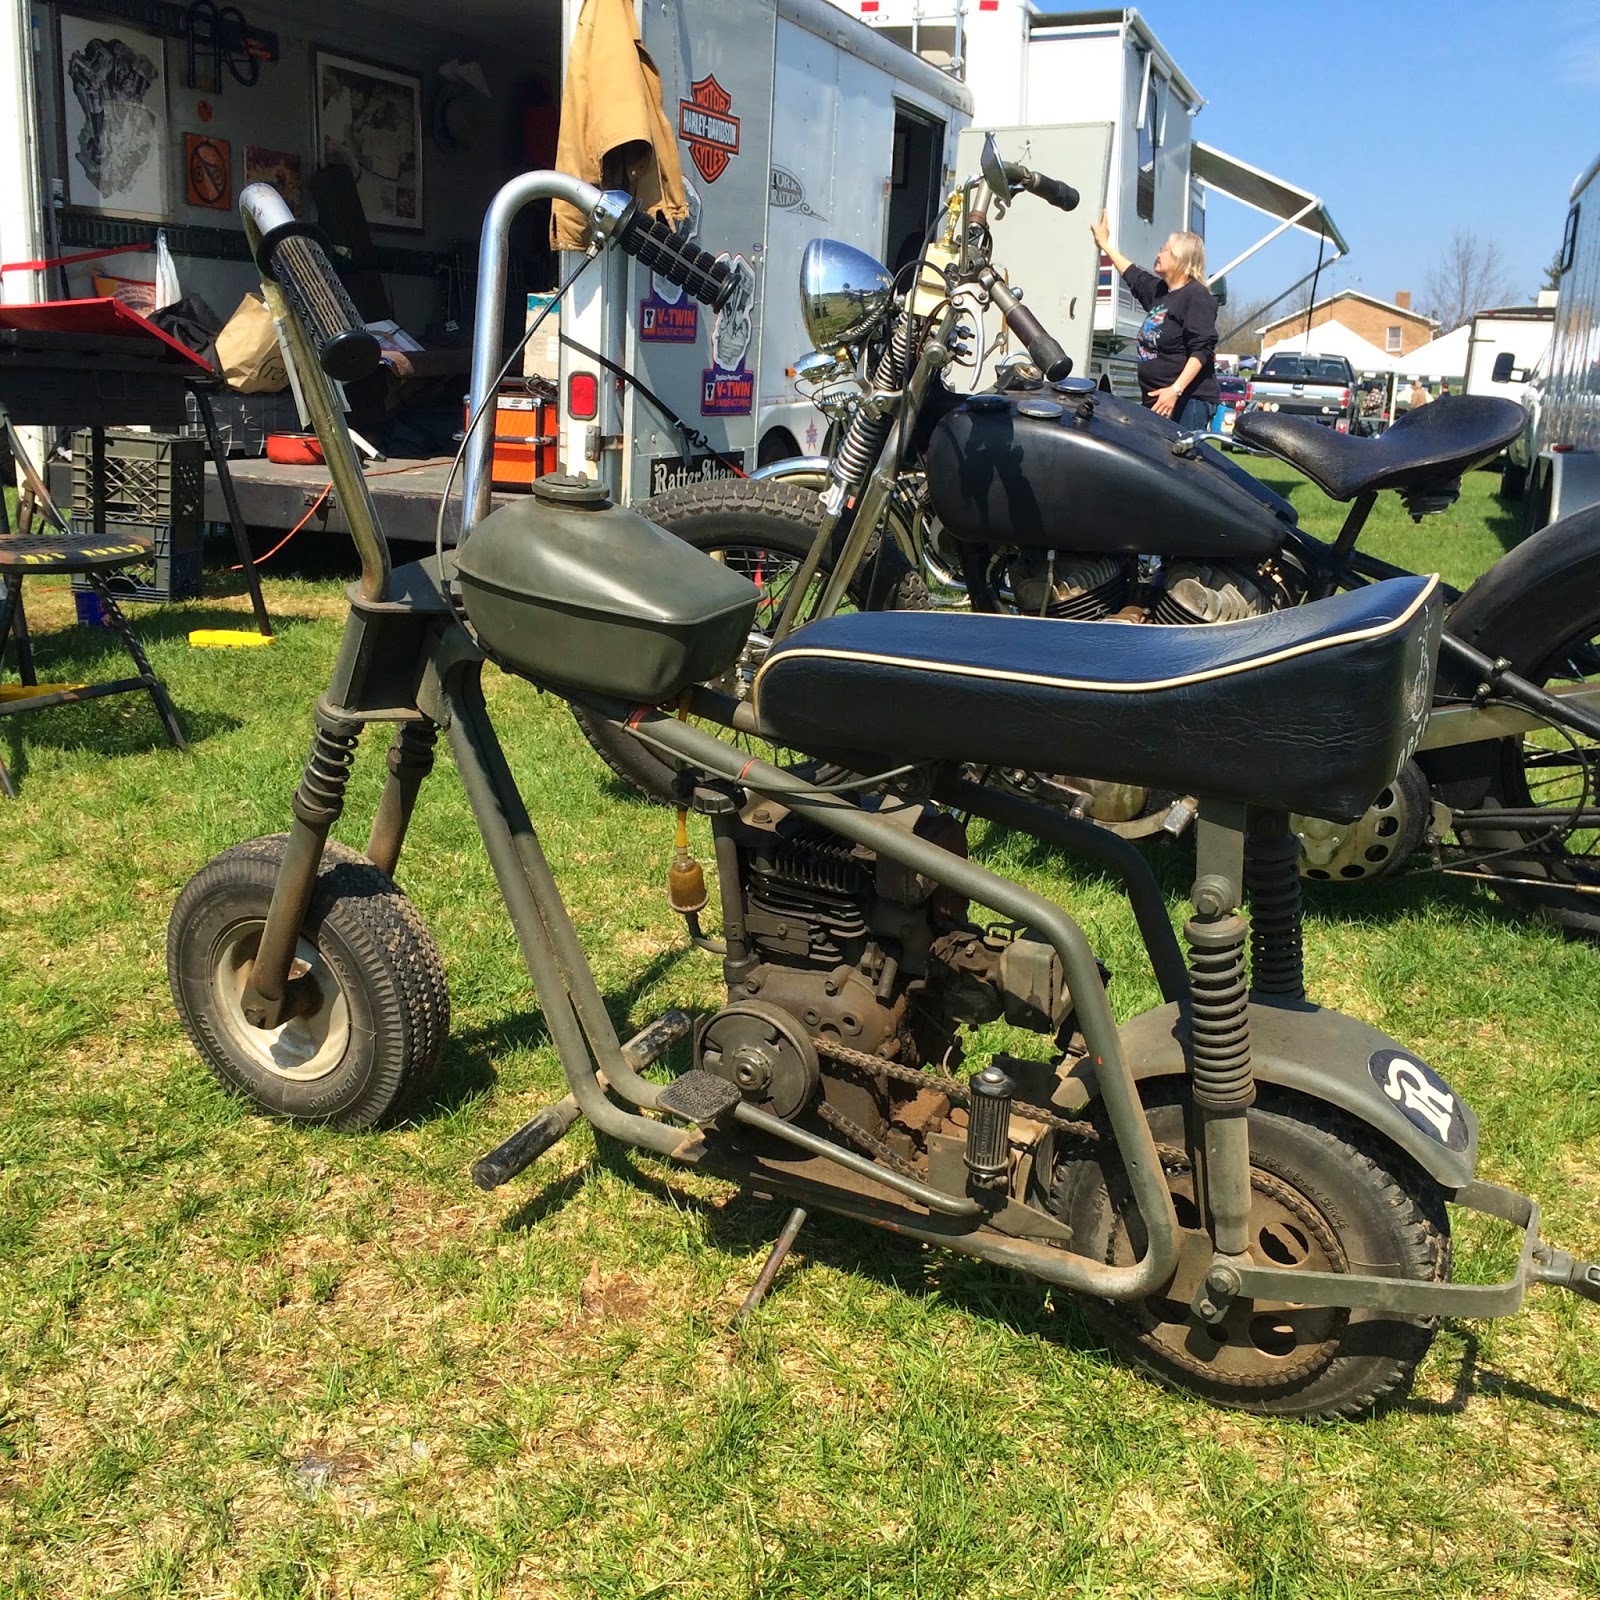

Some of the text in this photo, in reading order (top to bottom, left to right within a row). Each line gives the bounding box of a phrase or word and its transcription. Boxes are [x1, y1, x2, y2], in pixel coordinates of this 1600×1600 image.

[696, 84, 728, 114] MOTOR
[684, 108, 737, 146] HARLEY-DAVIDSON
[694, 143, 725, 174] CYCLES
[657, 308, 696, 326] V-TWIN
[716, 381, 751, 397] V-TWIN
[1264, 1155, 1283, 1170] FOR
[1284, 1166, 1324, 1197] HIGHWAY
[1320, 1197, 1350, 1231] SERVICE
